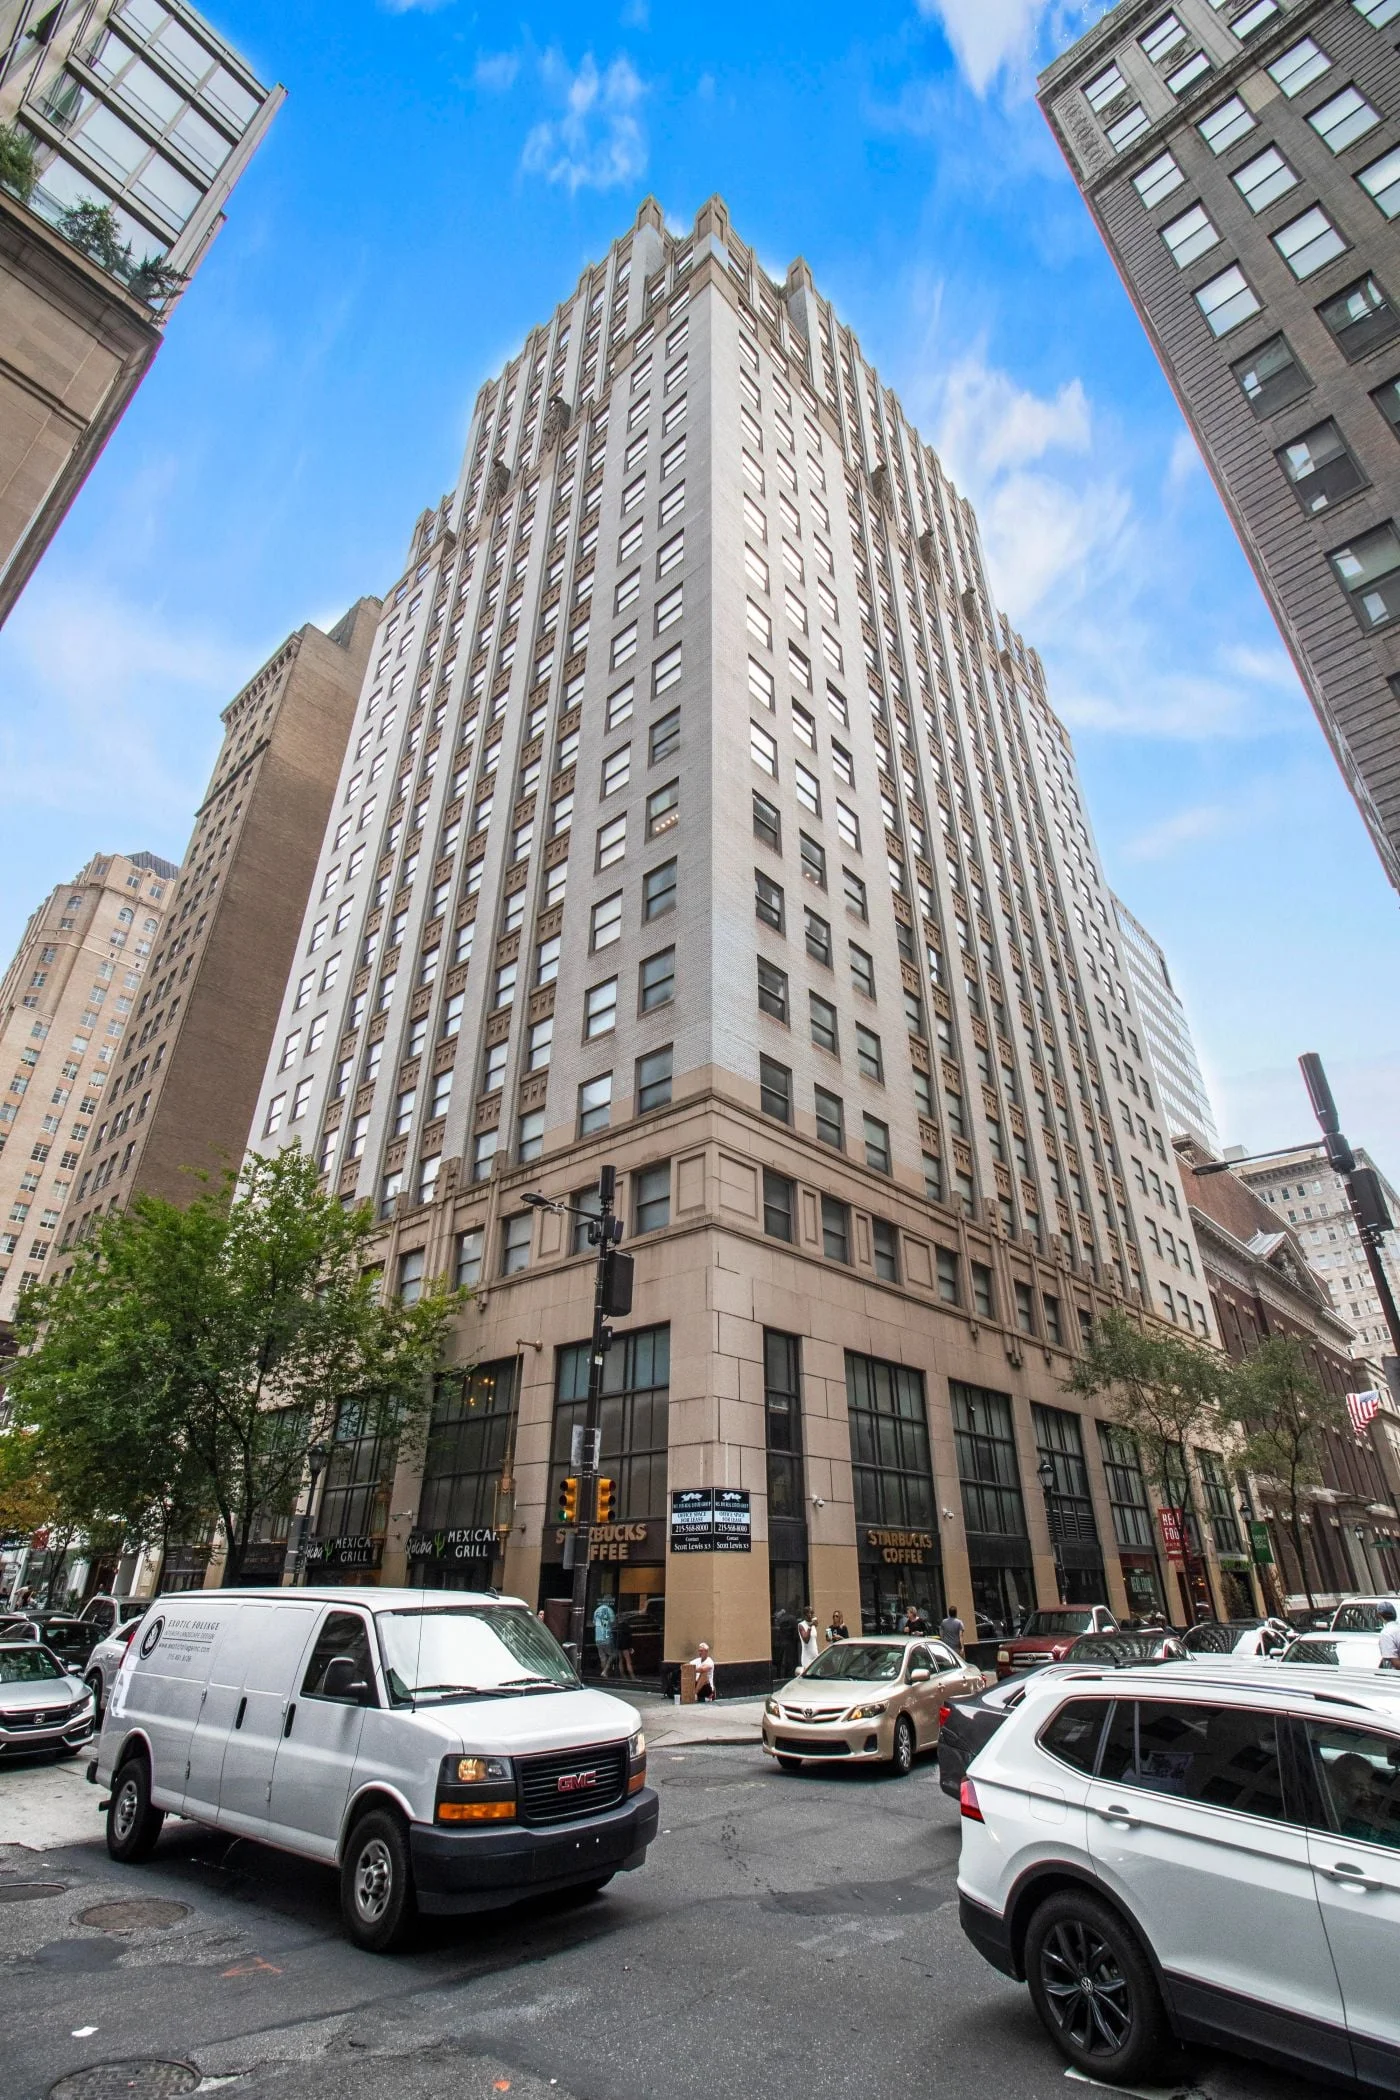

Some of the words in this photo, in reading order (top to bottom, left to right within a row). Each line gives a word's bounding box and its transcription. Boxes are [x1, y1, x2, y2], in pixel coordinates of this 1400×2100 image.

[555, 1523, 647, 1544] STBUCKS
[867, 1530, 933, 1549] STARBUCKS
[1164, 1527, 1180, 1540] FOO
[335, 1537, 372, 1549] MEXICA
[674, 1543, 688, 1551] Scott
[688, 1542, 703, 1550] Lewis
[716, 1541, 729, 1549] Scott
[729, 1541, 743, 1549] Lewis
[340, 1551, 368, 1562] GRILL
[455, 1545, 488, 1558] GRILL
[590, 1543, 629, 1560] FFEE
[882, 1547, 923, 1564] COFFEE
[168, 1619, 191, 1629] EXOTIC
[191, 1621, 221, 1631] FOLIAGE
[557, 1770, 597, 1792] GMC
